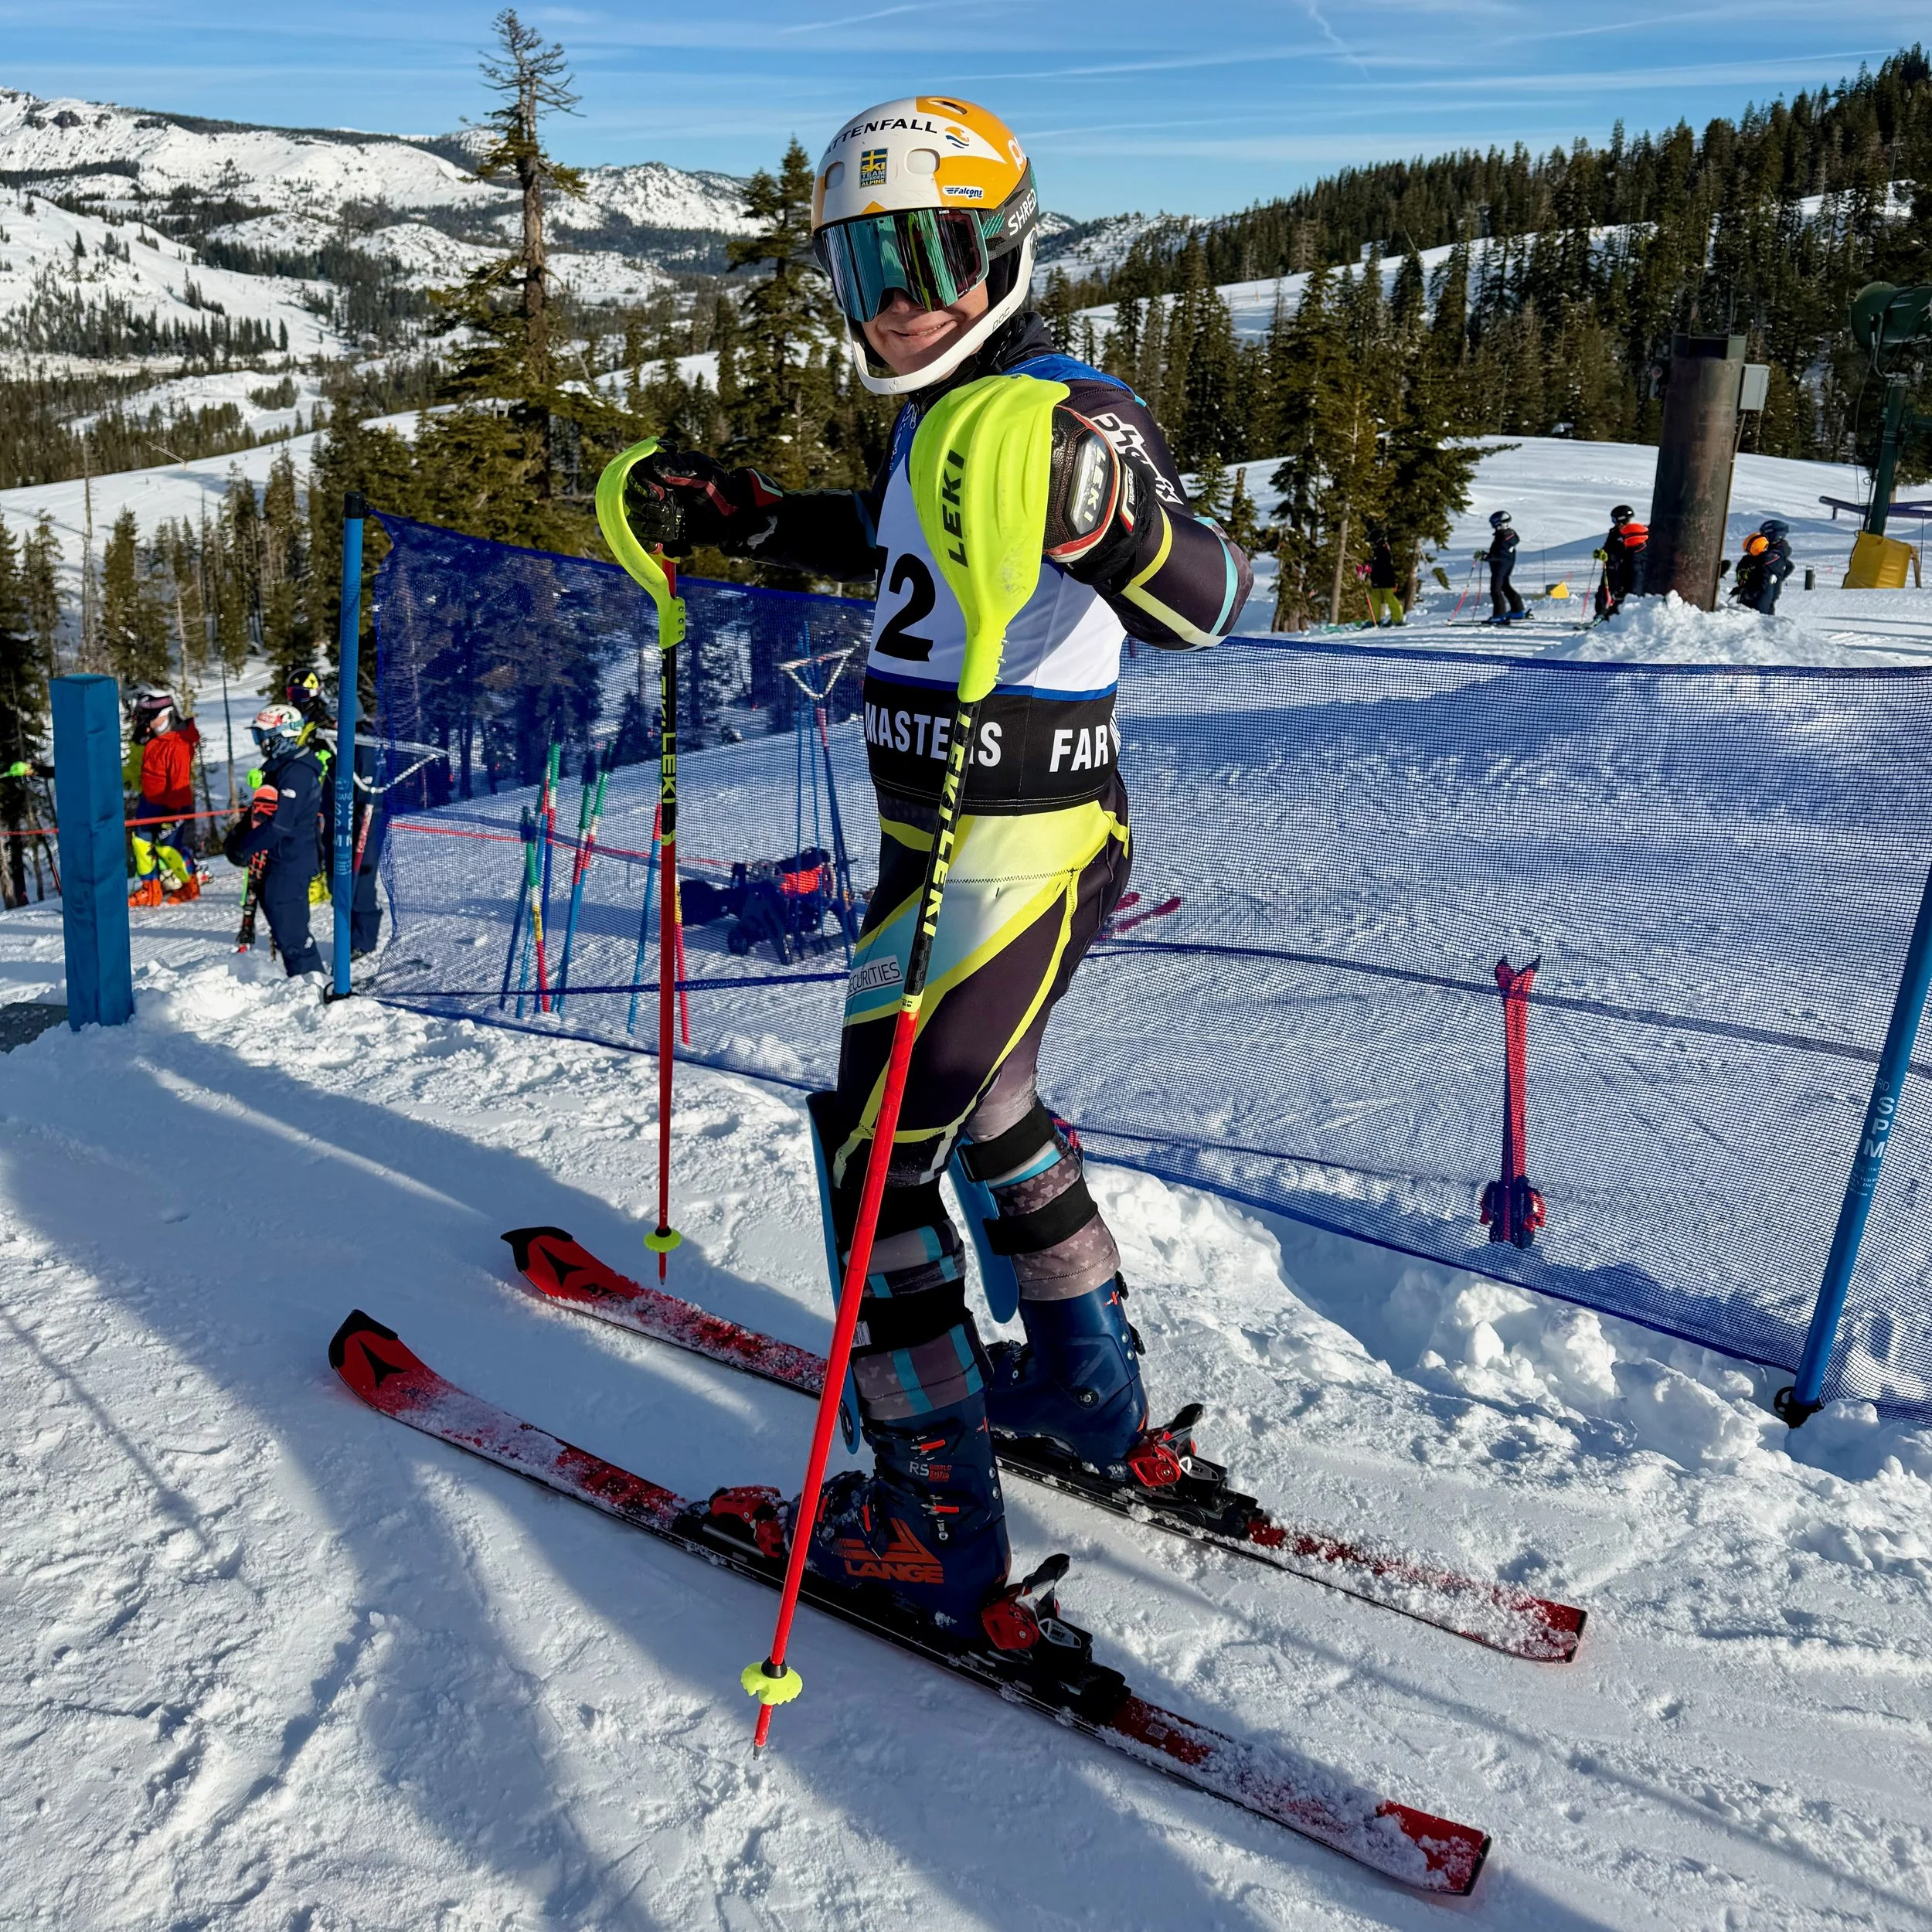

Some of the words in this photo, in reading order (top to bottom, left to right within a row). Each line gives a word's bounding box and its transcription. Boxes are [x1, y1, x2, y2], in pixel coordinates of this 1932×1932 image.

[827, 118, 937, 153] TTENFALL
[861, 170, 885, 179] TEAM
[862, 162, 886, 173] SKI
[1008, 189, 1036, 236] SHRED
[1084, 444, 1106, 522] LEKI
[941, 449, 969, 568] LEKI
[865, 702, 1002, 767] MASTES
[1049, 724, 1110, 772] FAR
[662, 732, 676, 803] LEKI
[923, 828, 956, 937] LEKI
[909, 1461, 930, 1477] RS
[844, 1560, 944, 1583] LANGE
